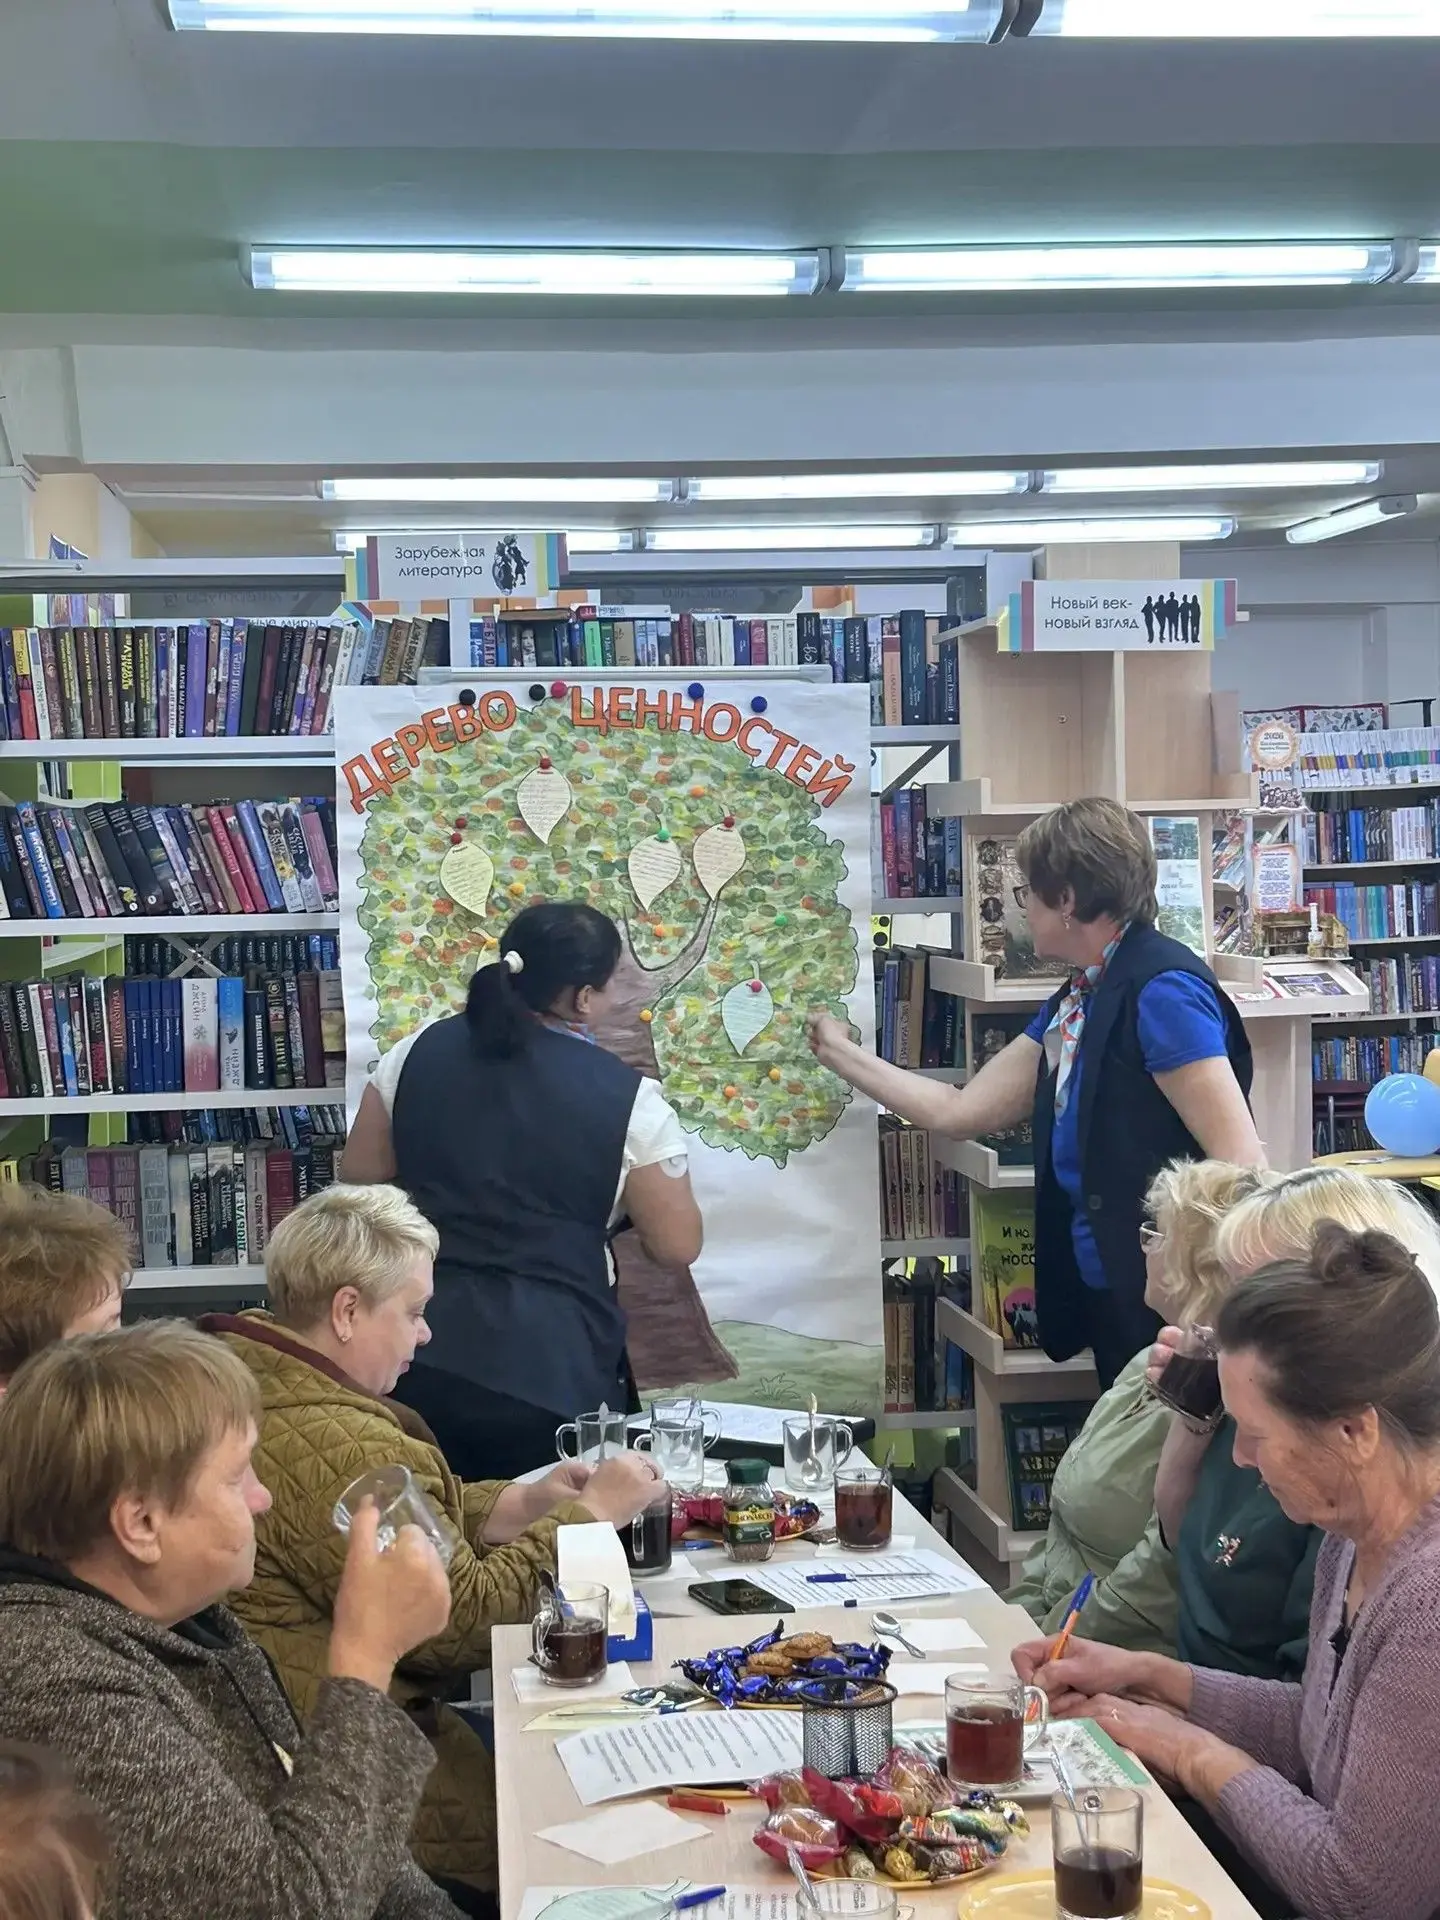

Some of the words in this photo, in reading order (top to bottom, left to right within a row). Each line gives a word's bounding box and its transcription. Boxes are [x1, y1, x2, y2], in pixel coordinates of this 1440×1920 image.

[395, 545, 485, 561] Зарубежная
[398, 565, 483, 577] литература
[1050, 594, 1099, 609] Новый
[1103, 596, 1132, 609] век-
[1045, 615, 1091, 629] новый
[1095, 617, 1139, 630] взгляд
[340, 690, 517, 814] ДЕРЕВО
[569, 686, 856, 808] ЦЕННОСТЕЙ
[232, 1048, 240, 1086] ДЖЕЙН
[1001, 1253, 1036, 1266] носо
[736, 1511, 773, 1522] MONARCH
